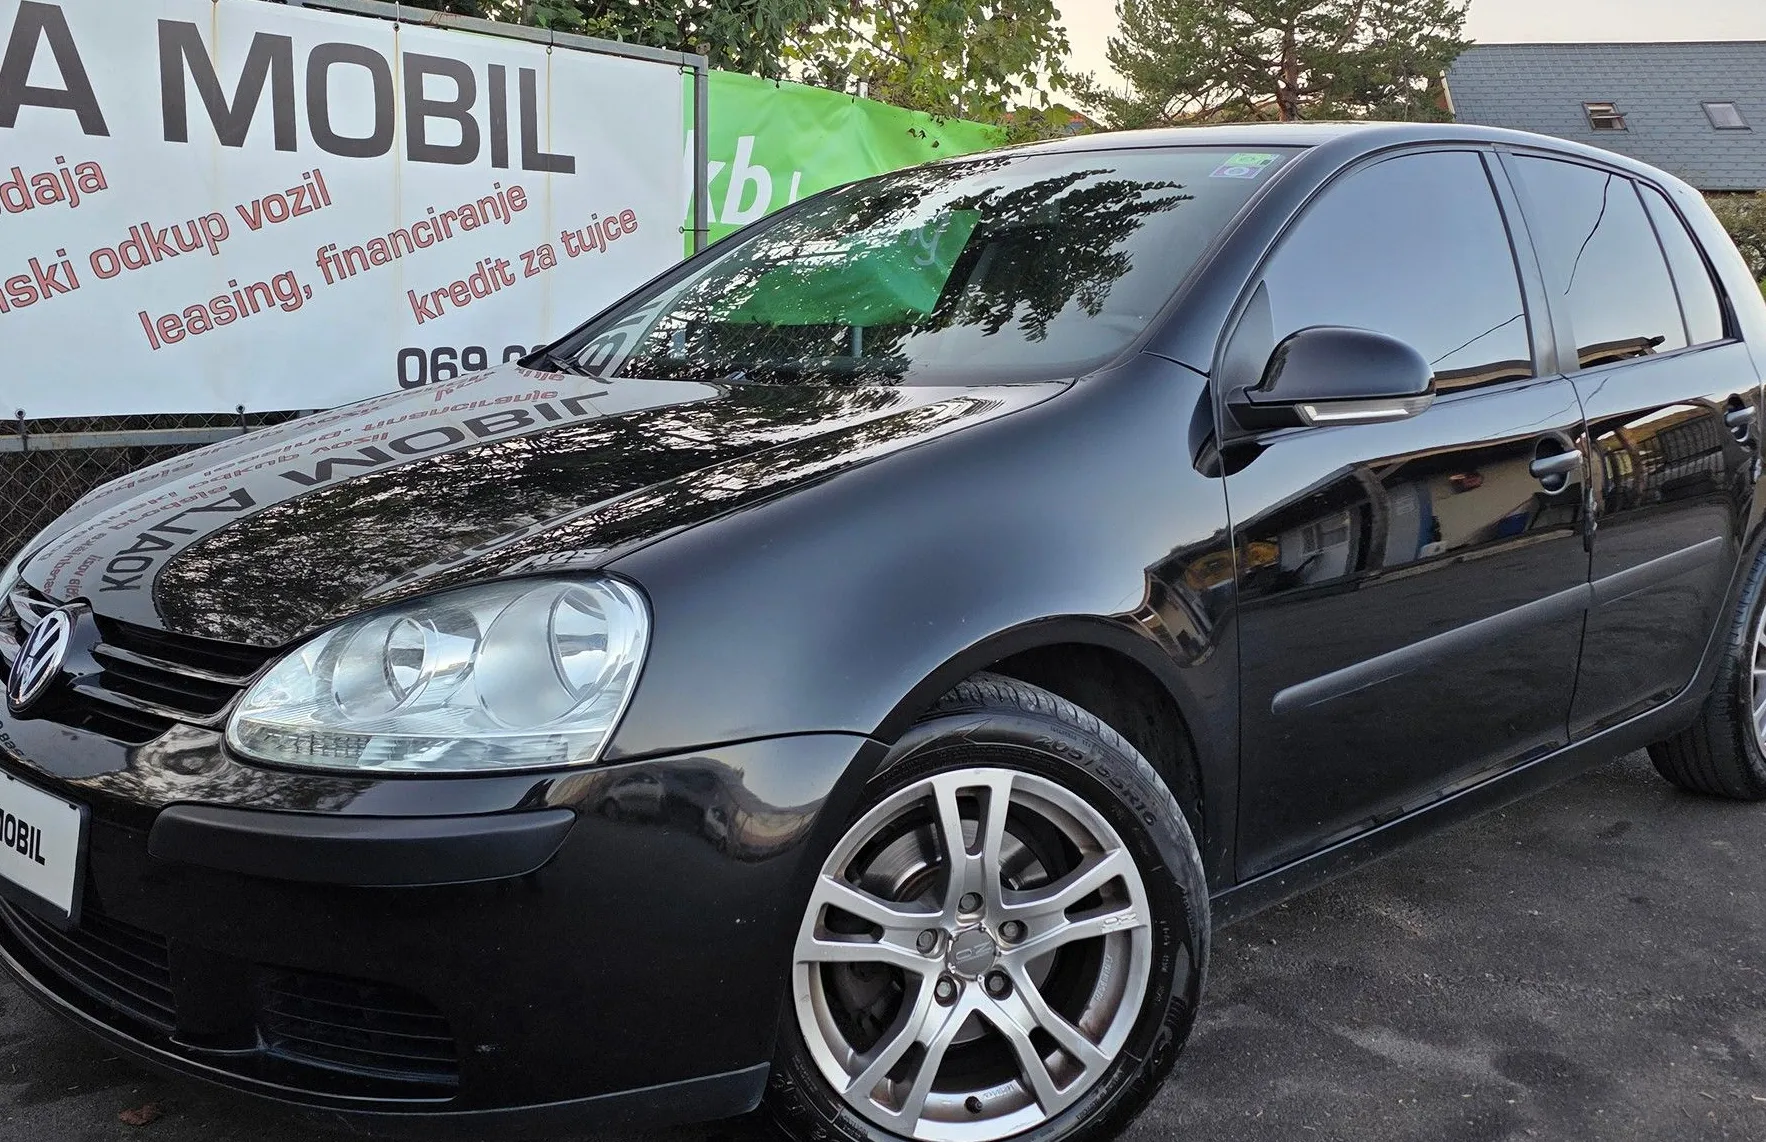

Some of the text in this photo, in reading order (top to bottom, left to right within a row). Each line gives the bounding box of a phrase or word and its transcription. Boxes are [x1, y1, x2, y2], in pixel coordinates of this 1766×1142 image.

[158, 19, 576, 174] MOBIL
[0, 156, 108, 213] daja
[90, 213, 229, 280] odkup
[236, 169, 332, 231] vozil
[139, 182, 527, 350] leasing, financiranje
[407, 207, 638, 325] kredit za tujce
